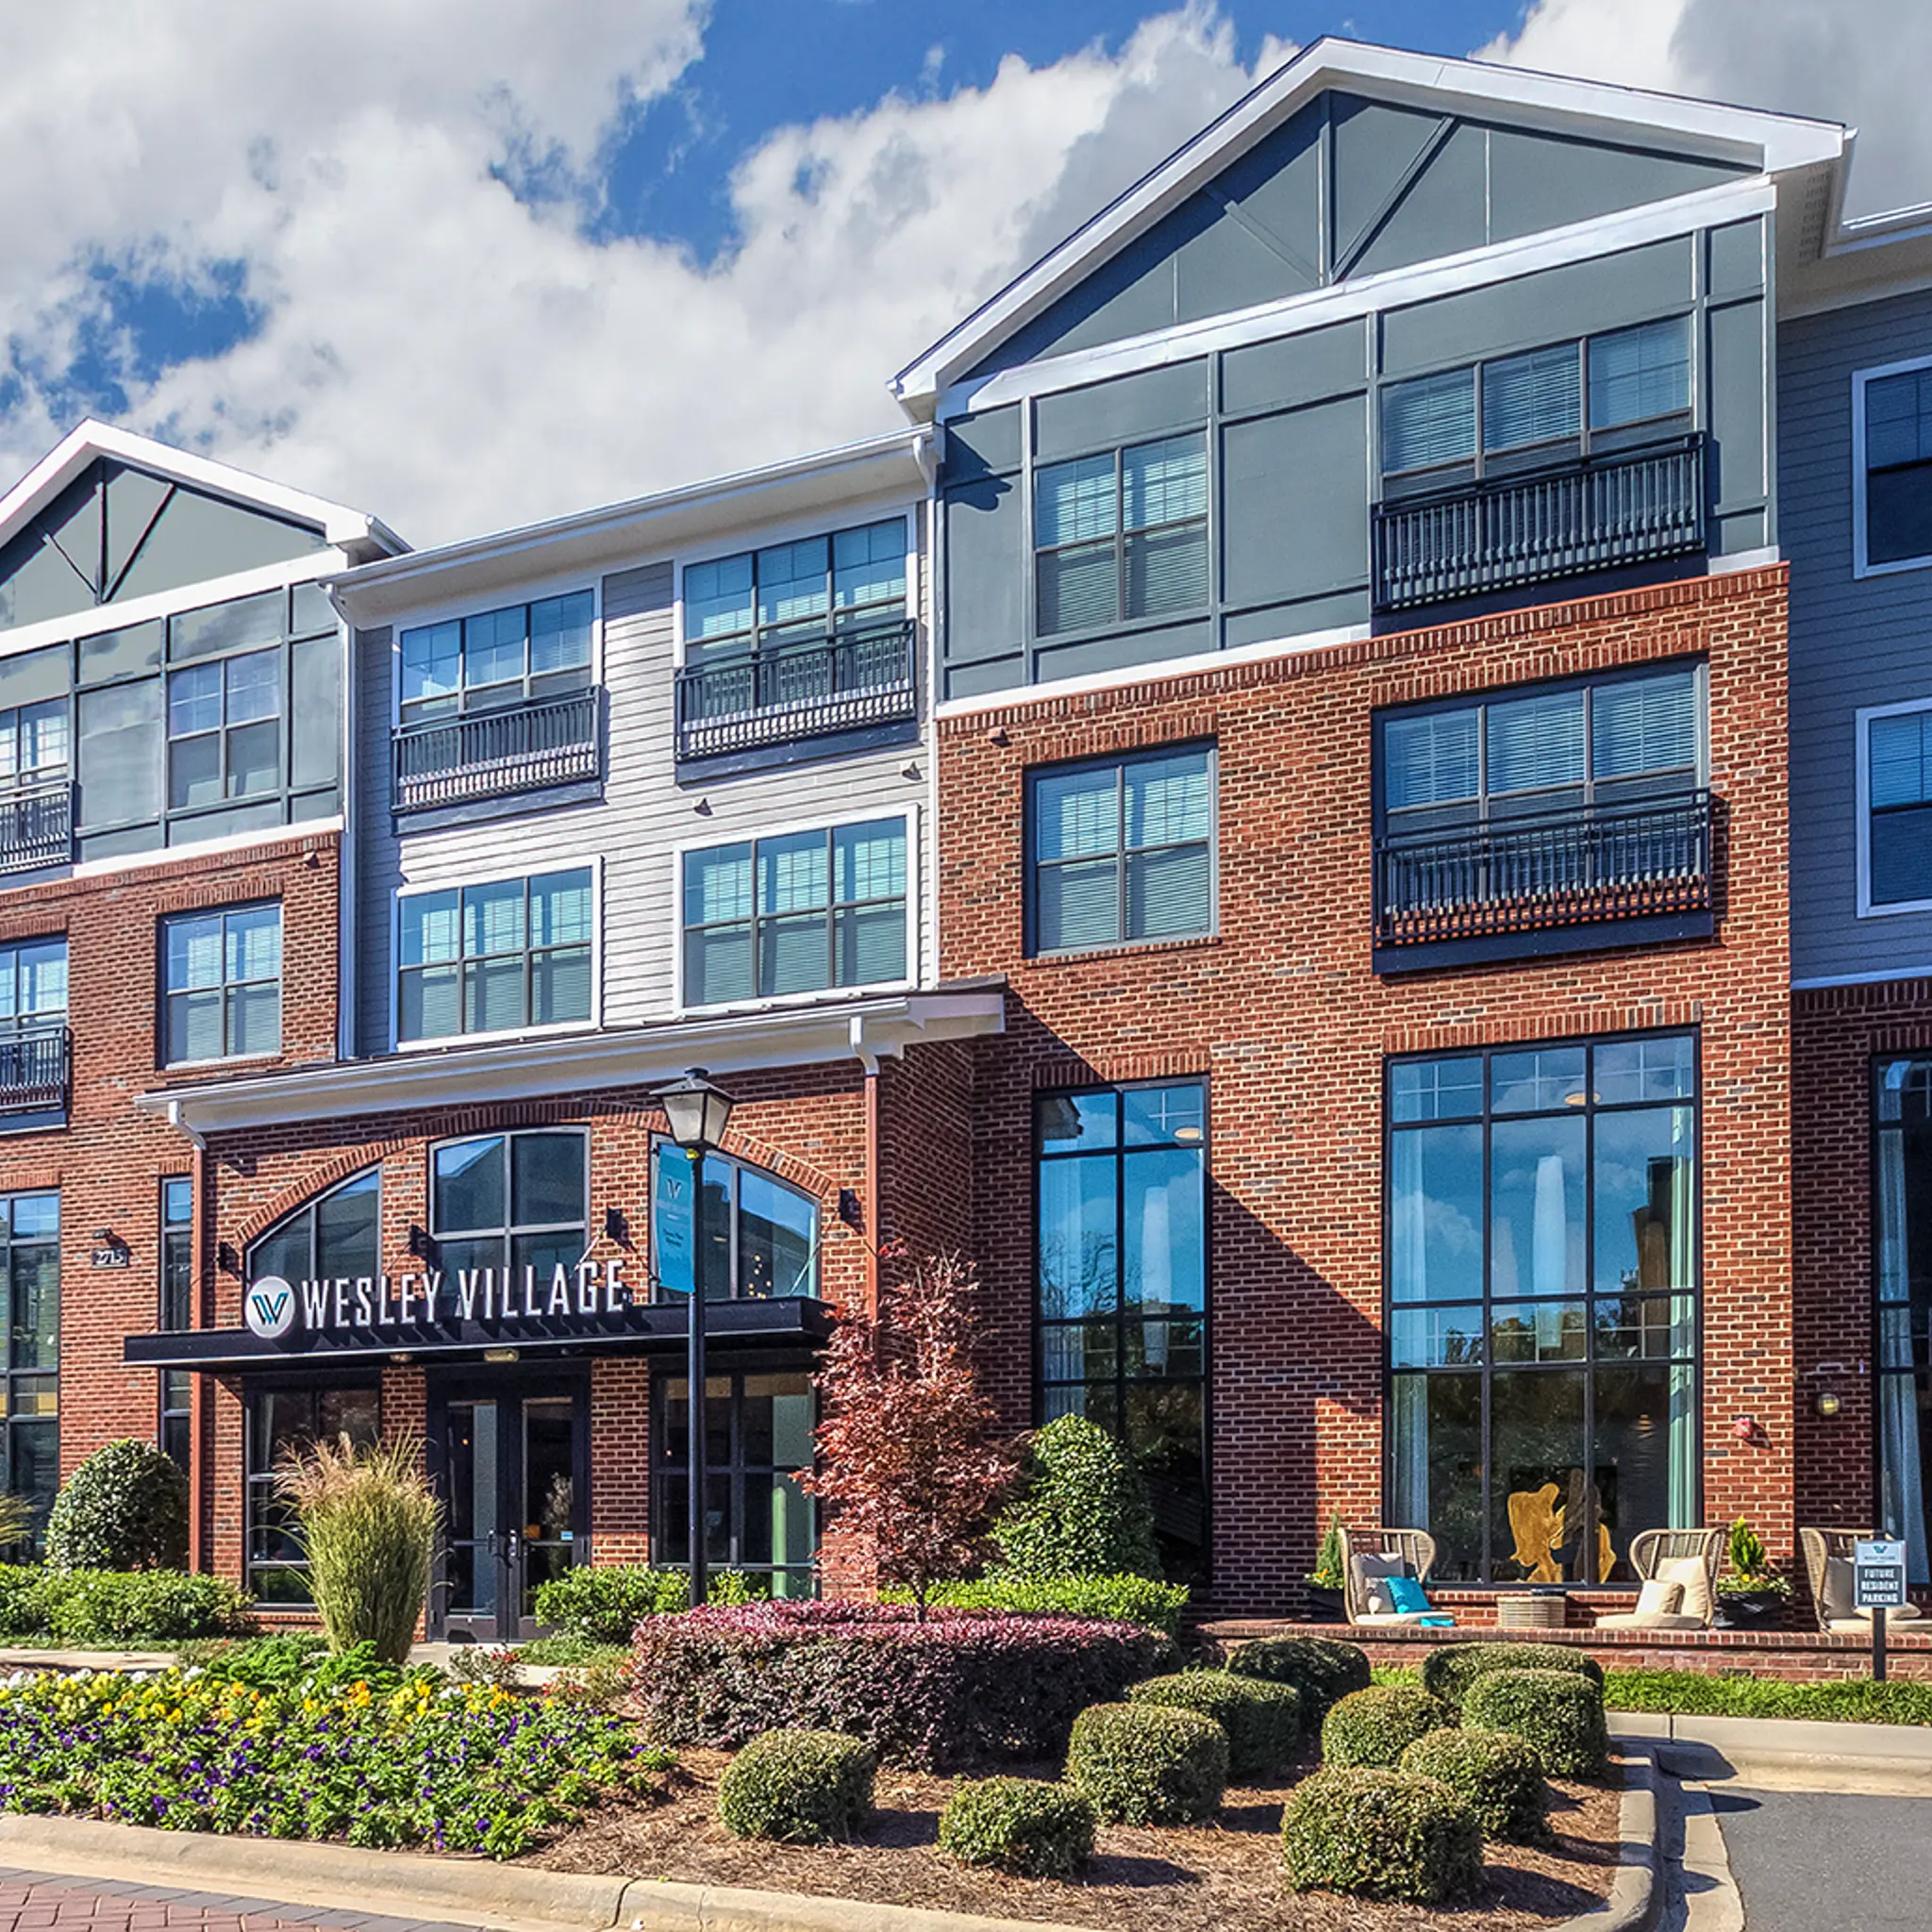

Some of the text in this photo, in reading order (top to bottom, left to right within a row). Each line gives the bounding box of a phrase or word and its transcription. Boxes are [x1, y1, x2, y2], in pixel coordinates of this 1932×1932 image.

[301, 1271, 442, 1329] WESLEY
[458, 1259, 625, 1320] VILLAGE
[1864, 1569, 1895, 1578] FUTURE
[1861, 1581, 1899, 1591] RESIDENT
[1862, 1593, 1898, 1603] PARKING
